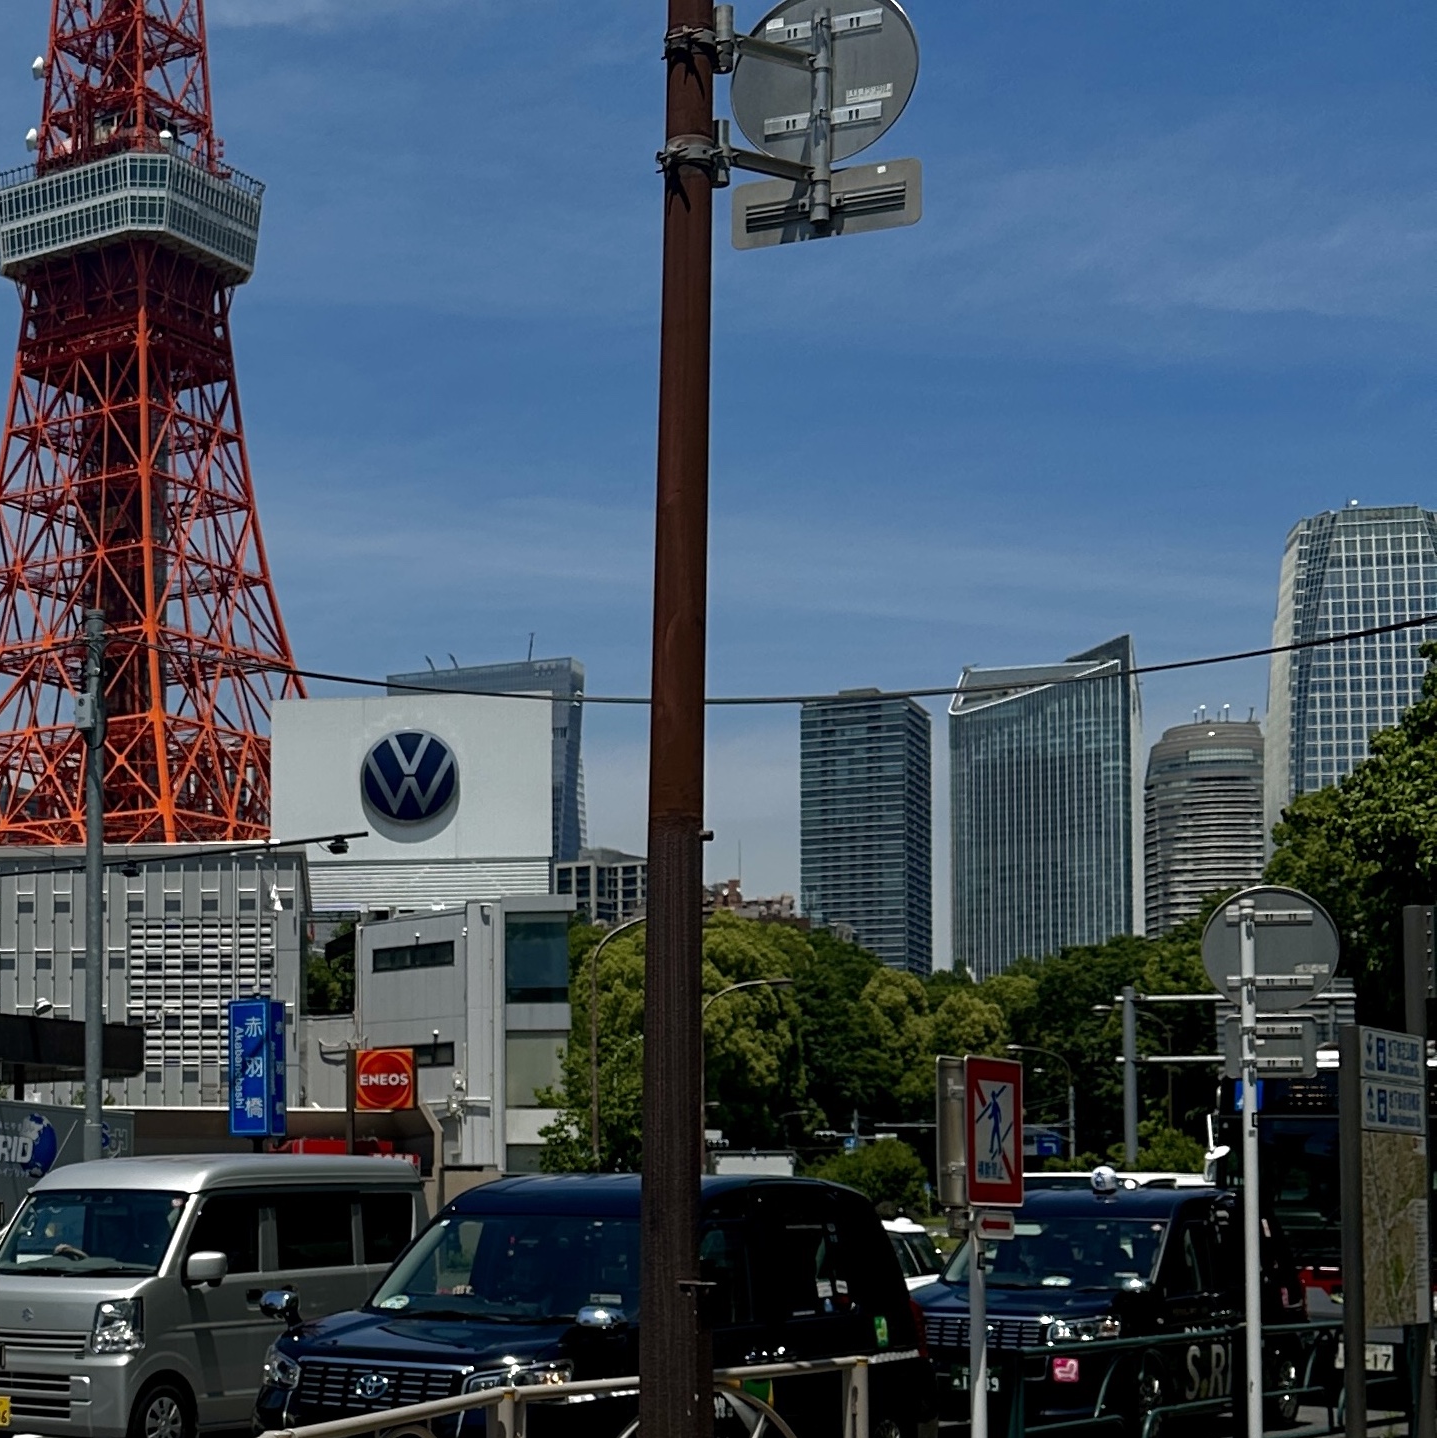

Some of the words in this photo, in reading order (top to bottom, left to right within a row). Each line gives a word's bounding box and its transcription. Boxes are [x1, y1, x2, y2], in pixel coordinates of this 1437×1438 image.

[244, 1016, 263, 1119] 赤羽橋
[359, 1072, 409, 1086] ENEOS
